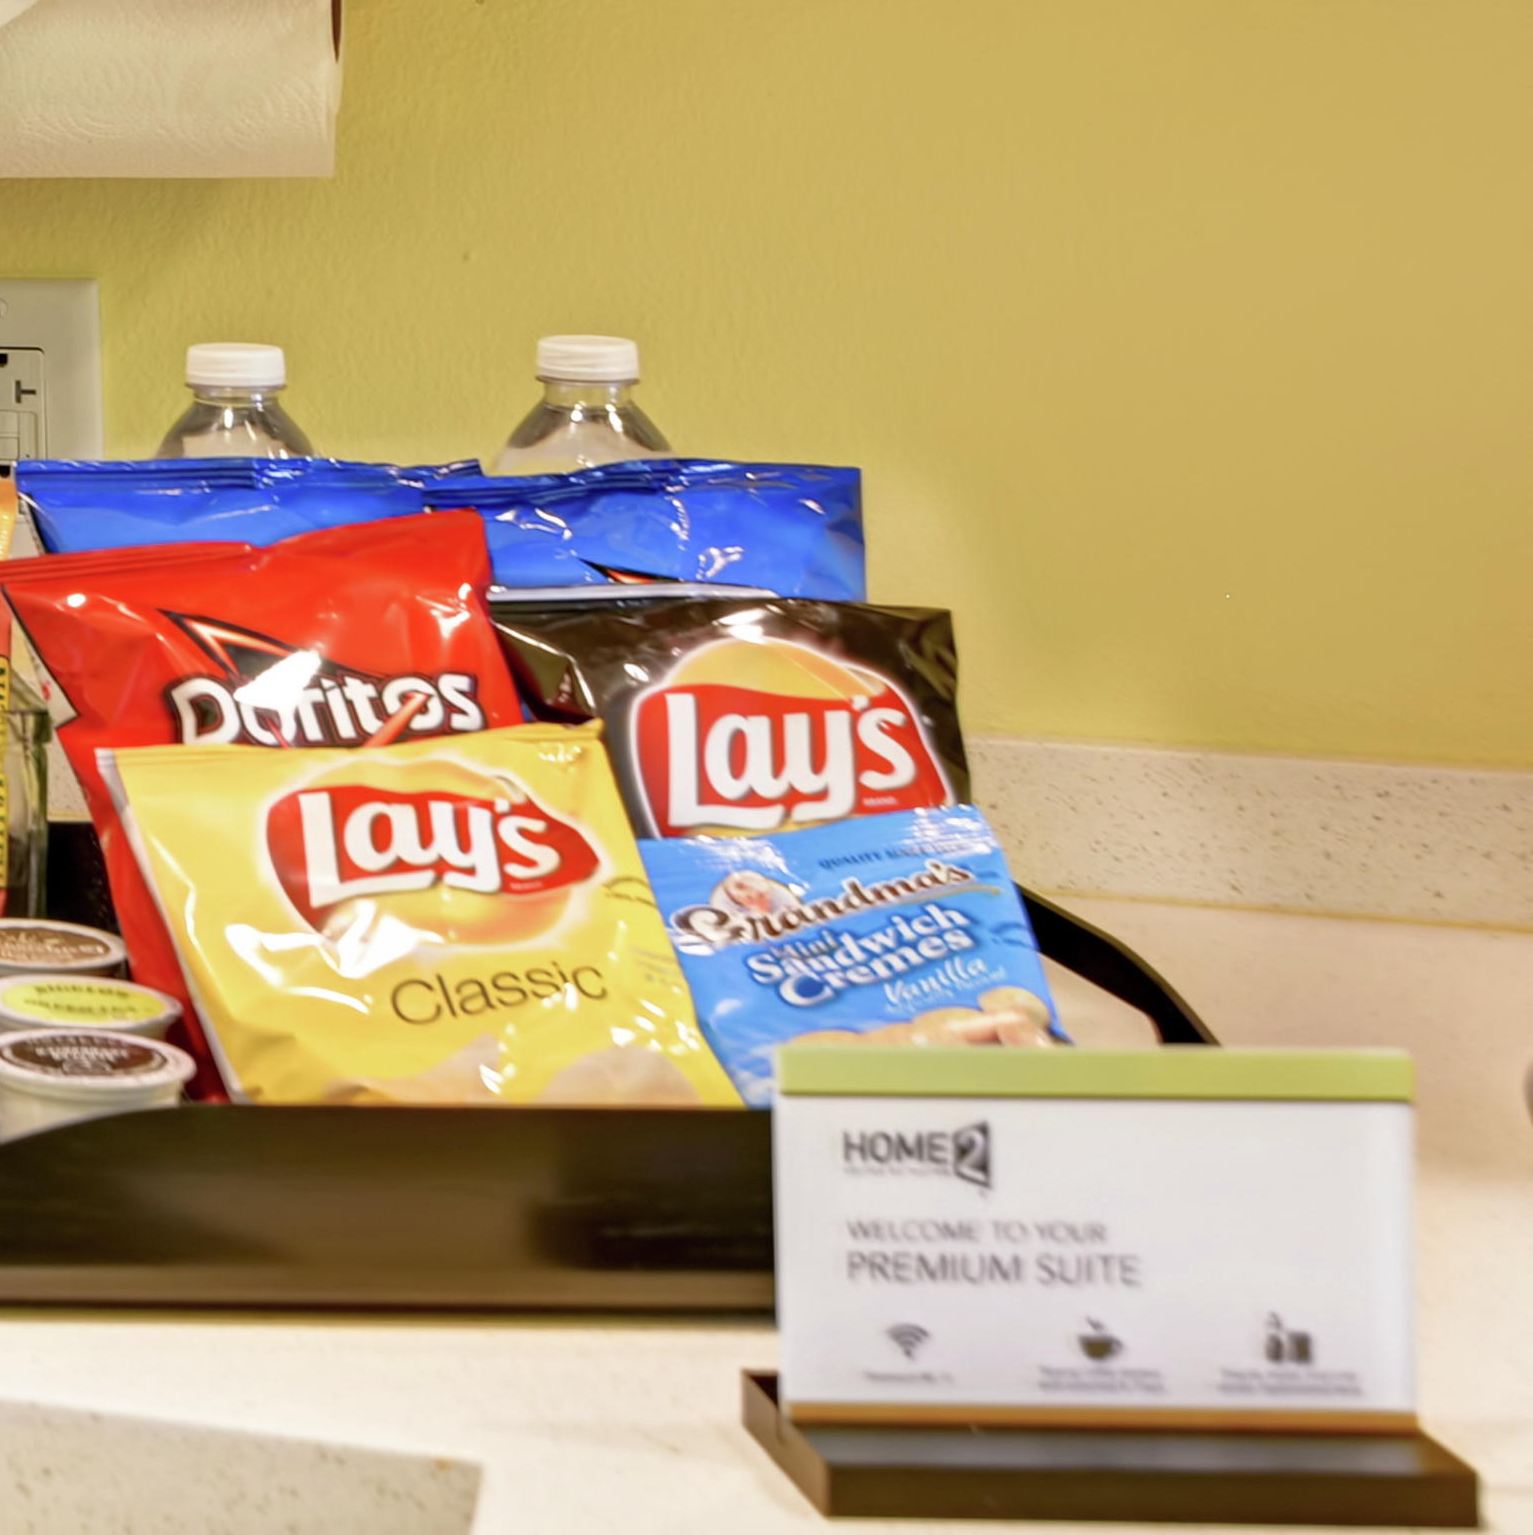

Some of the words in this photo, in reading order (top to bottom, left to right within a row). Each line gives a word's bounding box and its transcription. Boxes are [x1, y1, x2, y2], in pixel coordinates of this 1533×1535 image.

[171, 673, 482, 745] Doritos
[665, 693, 916, 830] Lay's
[298, 791, 561, 908] Lay's
[671, 858, 975, 945] Grandma's
[747, 904, 970, 984] Sandwich
[779, 927, 976, 1007] Cremes
[883, 955, 989, 1004] Vanilla
[390, 961, 609, 1026] Classic
[847, 1220, 979, 1243] WELCOME
[992, 1220, 1029, 1243] TO
[1034, 1220, 1108, 1244] YOUR
[847, 1250, 1023, 1284] PREMIUM
[1034, 1252, 1144, 1287] SUITE
